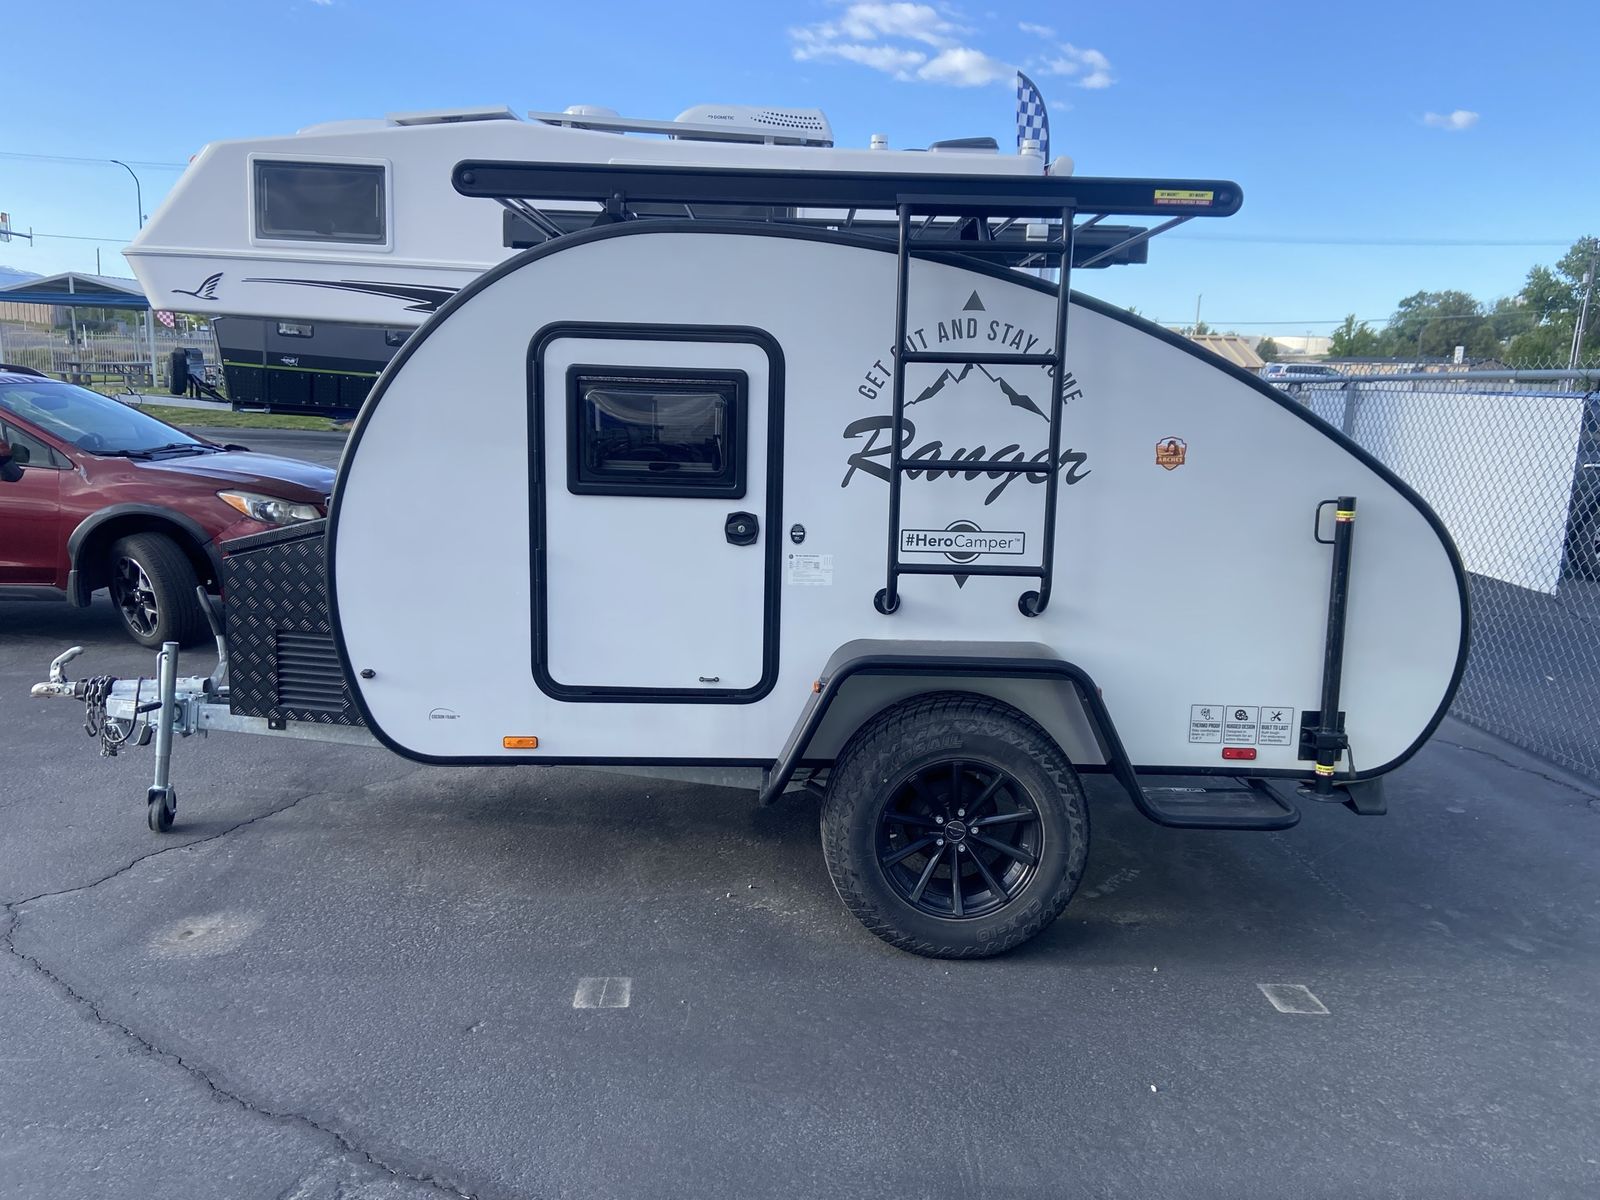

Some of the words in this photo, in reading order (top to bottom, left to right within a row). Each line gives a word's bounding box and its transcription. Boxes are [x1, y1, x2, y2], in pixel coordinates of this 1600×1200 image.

[857, 359, 892, 400] GET
[937, 317, 978, 343] AND
[987, 319, 1039, 355] STAY
[1040, 347, 1084, 405] ME
[840, 415, 1092, 506] Ranger
